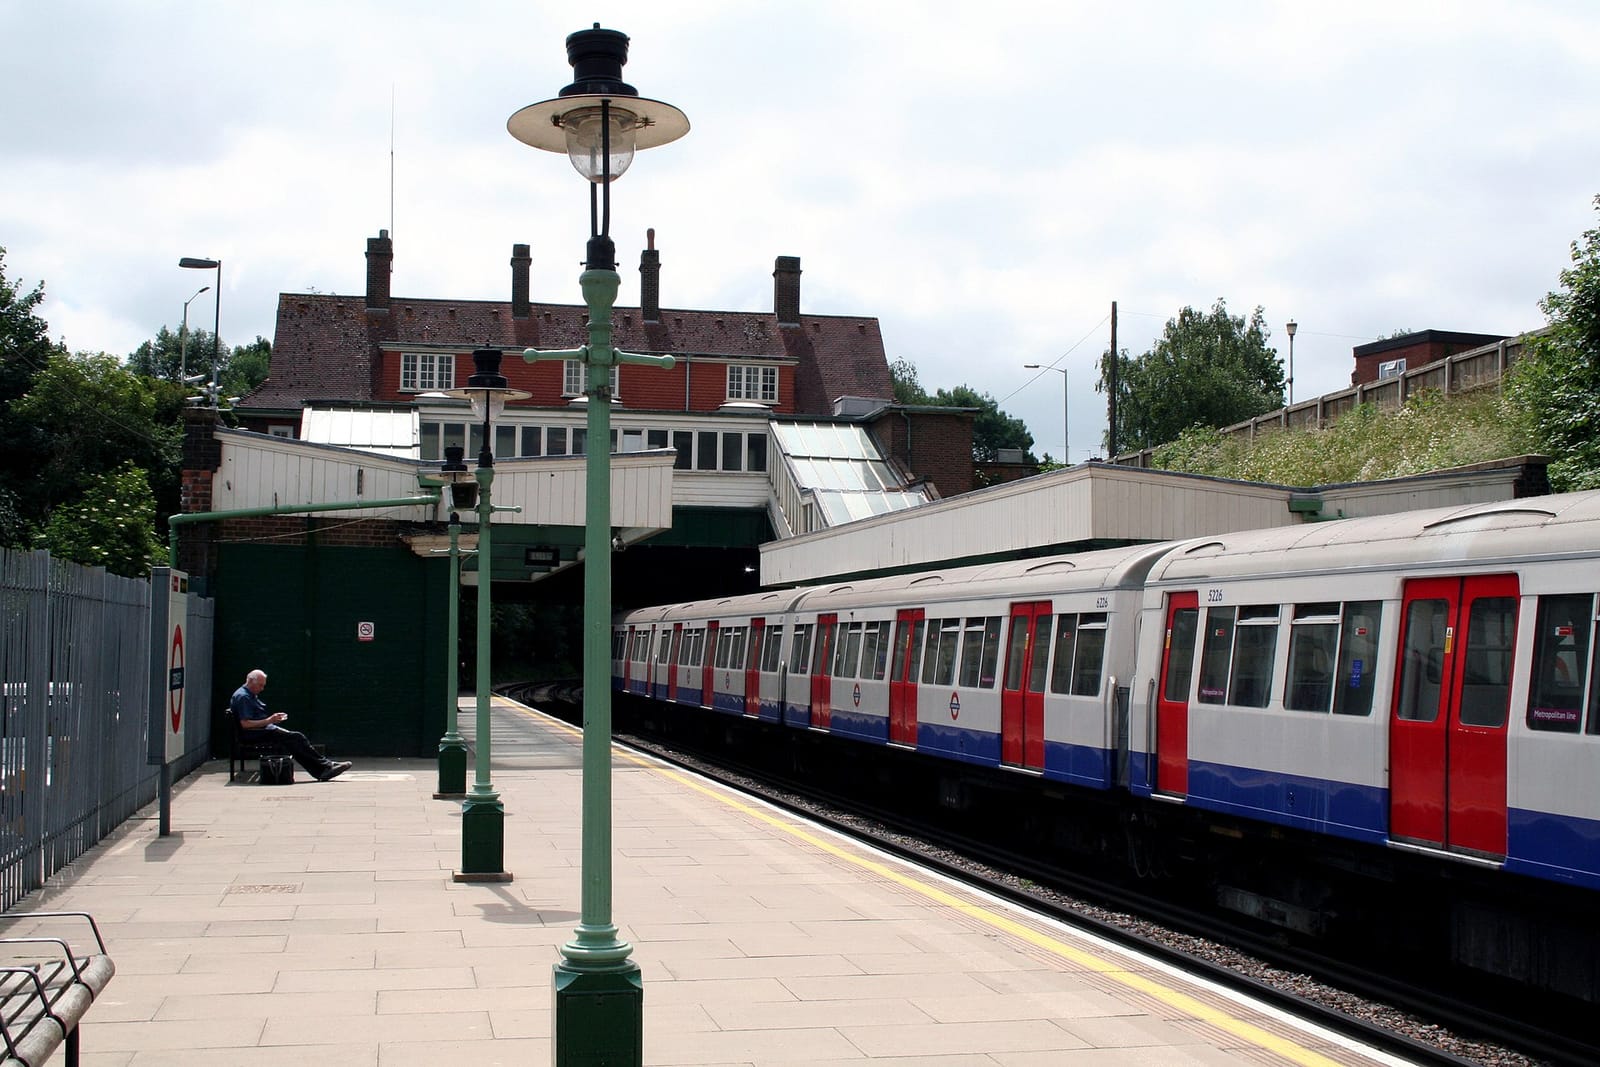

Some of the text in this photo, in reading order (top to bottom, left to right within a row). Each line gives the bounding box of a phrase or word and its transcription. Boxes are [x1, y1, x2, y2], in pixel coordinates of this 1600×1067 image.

[1208, 589, 1223, 602] 5226
[1096, 597, 1109, 608] 6226
[1534, 710, 1576, 720] Metropolitan line
